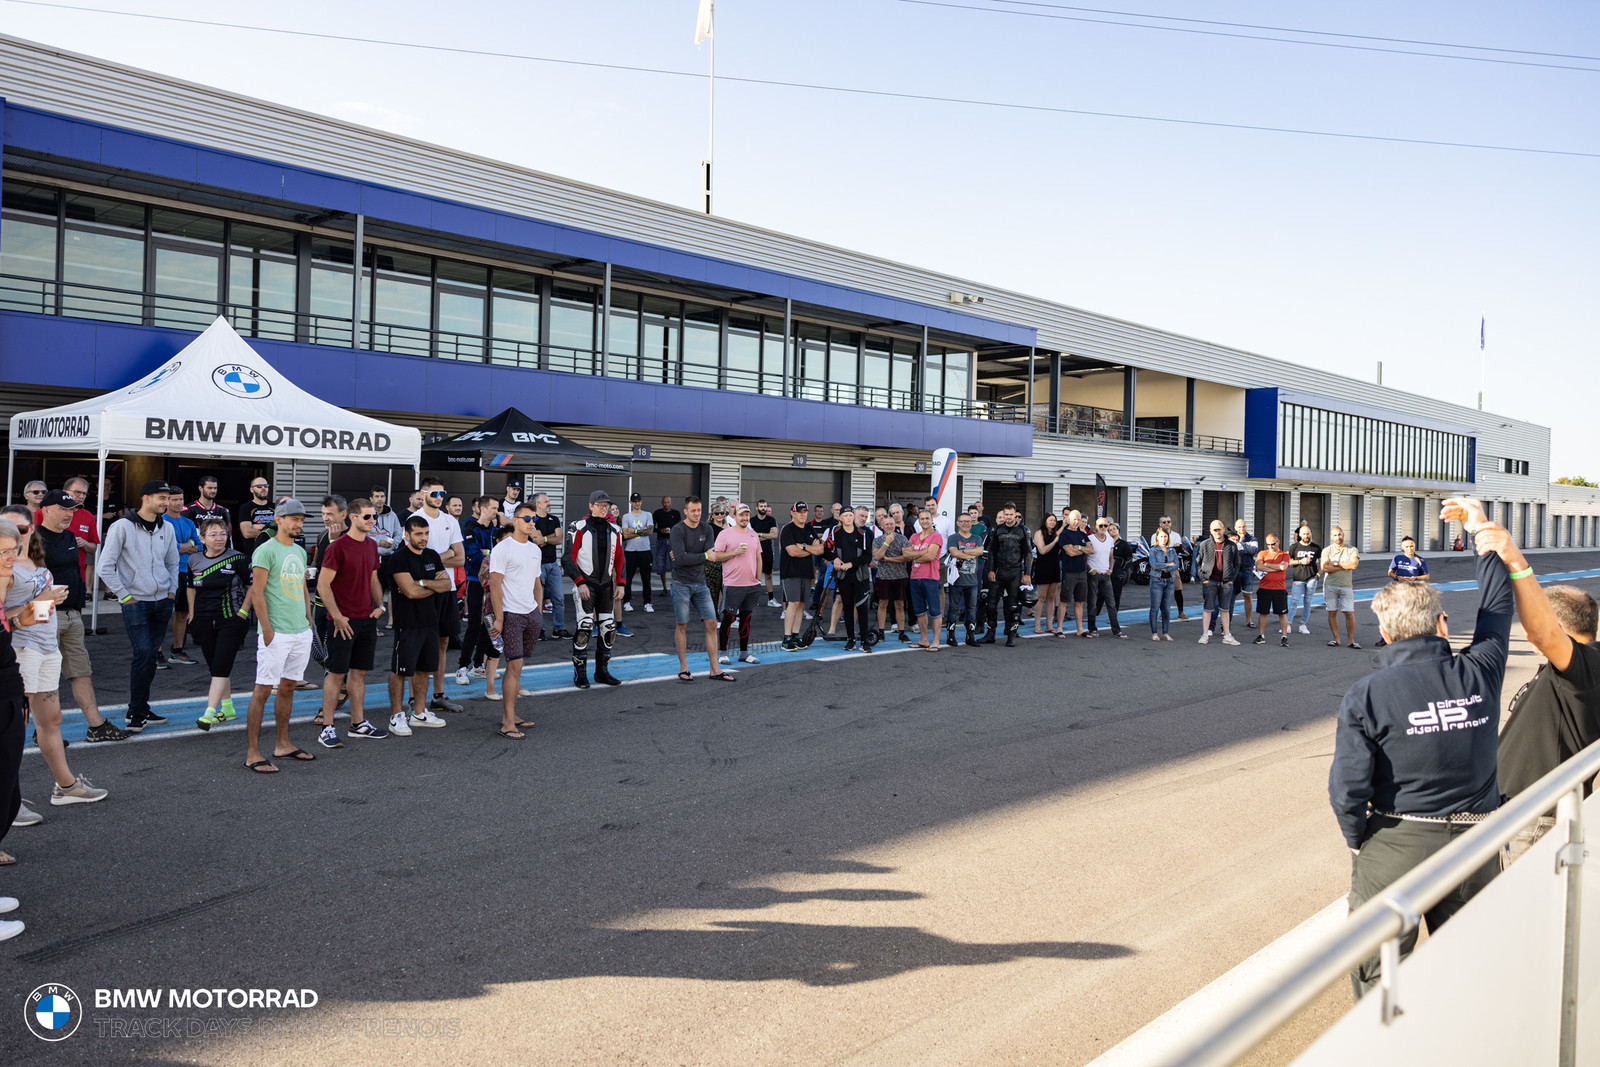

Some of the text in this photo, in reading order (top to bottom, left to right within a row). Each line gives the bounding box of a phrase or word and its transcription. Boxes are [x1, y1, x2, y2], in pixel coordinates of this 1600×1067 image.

[17, 415, 91, 438] BMW MOTORRAD
[145, 417, 392, 452] BMW MOTORRAD
[511, 432, 560, 445] BMC
[638, 448, 647, 456] 18
[585, 461, 624, 470] bmc-moto.com
[797, 457, 804, 465] 19
[917, 463, 925, 471] 20
[1436, 694, 1483, 709] circuit
